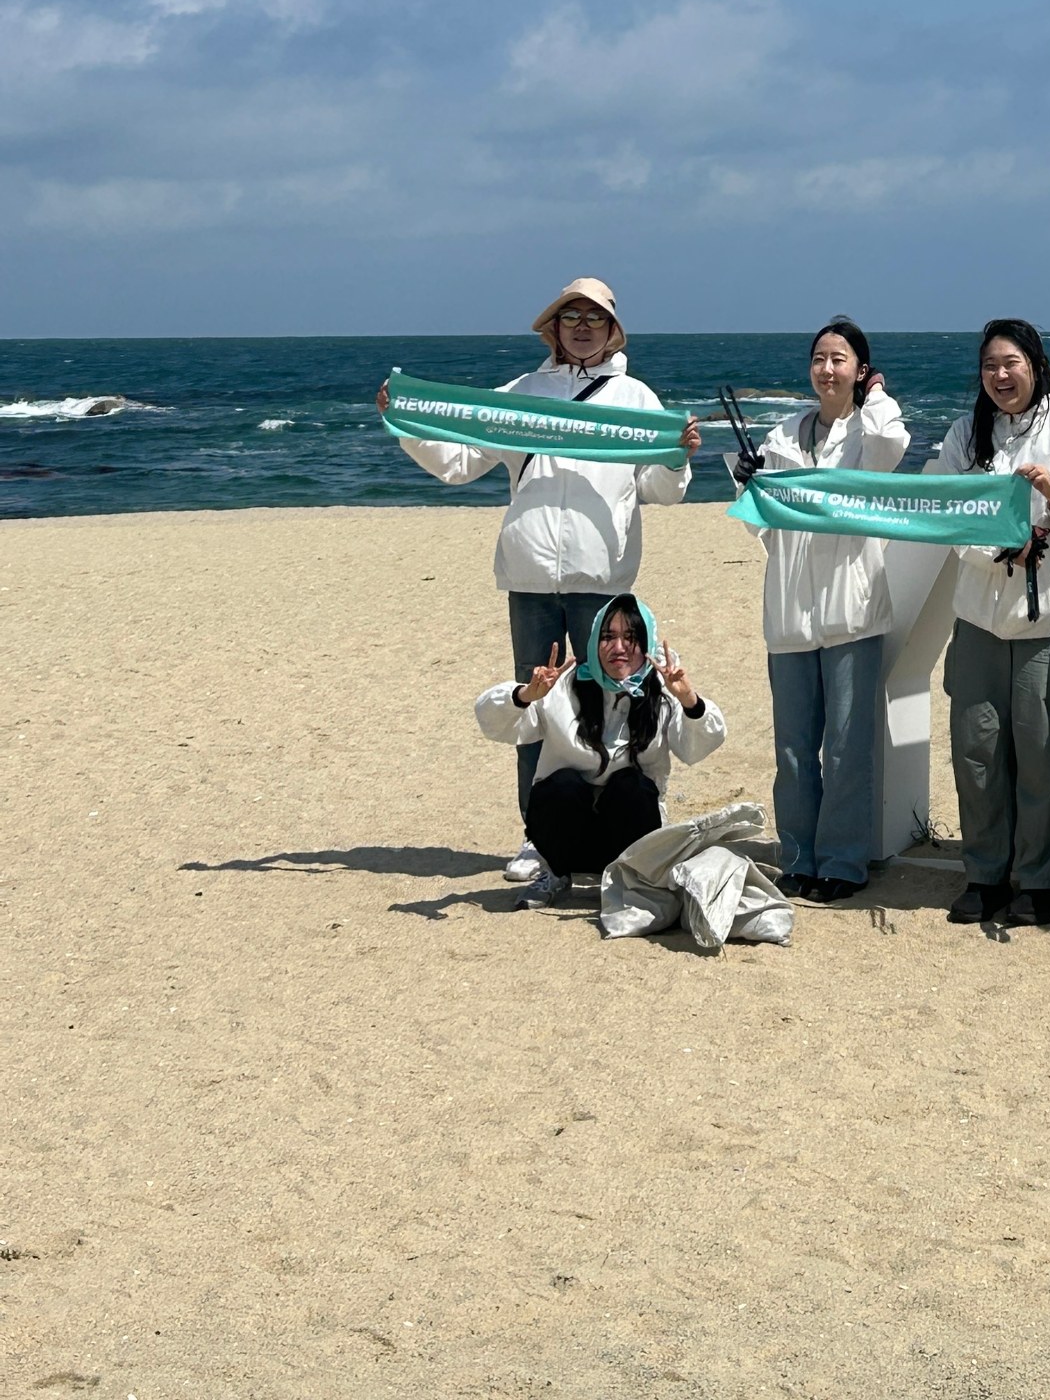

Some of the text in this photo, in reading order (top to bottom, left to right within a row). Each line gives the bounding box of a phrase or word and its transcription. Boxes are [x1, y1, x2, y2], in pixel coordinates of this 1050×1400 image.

[394, 396, 660, 443] REWRITE OUR NATURE STORY
[828, 493, 867, 510] OUR
[870, 496, 942, 514] NATURE
[945, 499, 1003, 517] STORY
